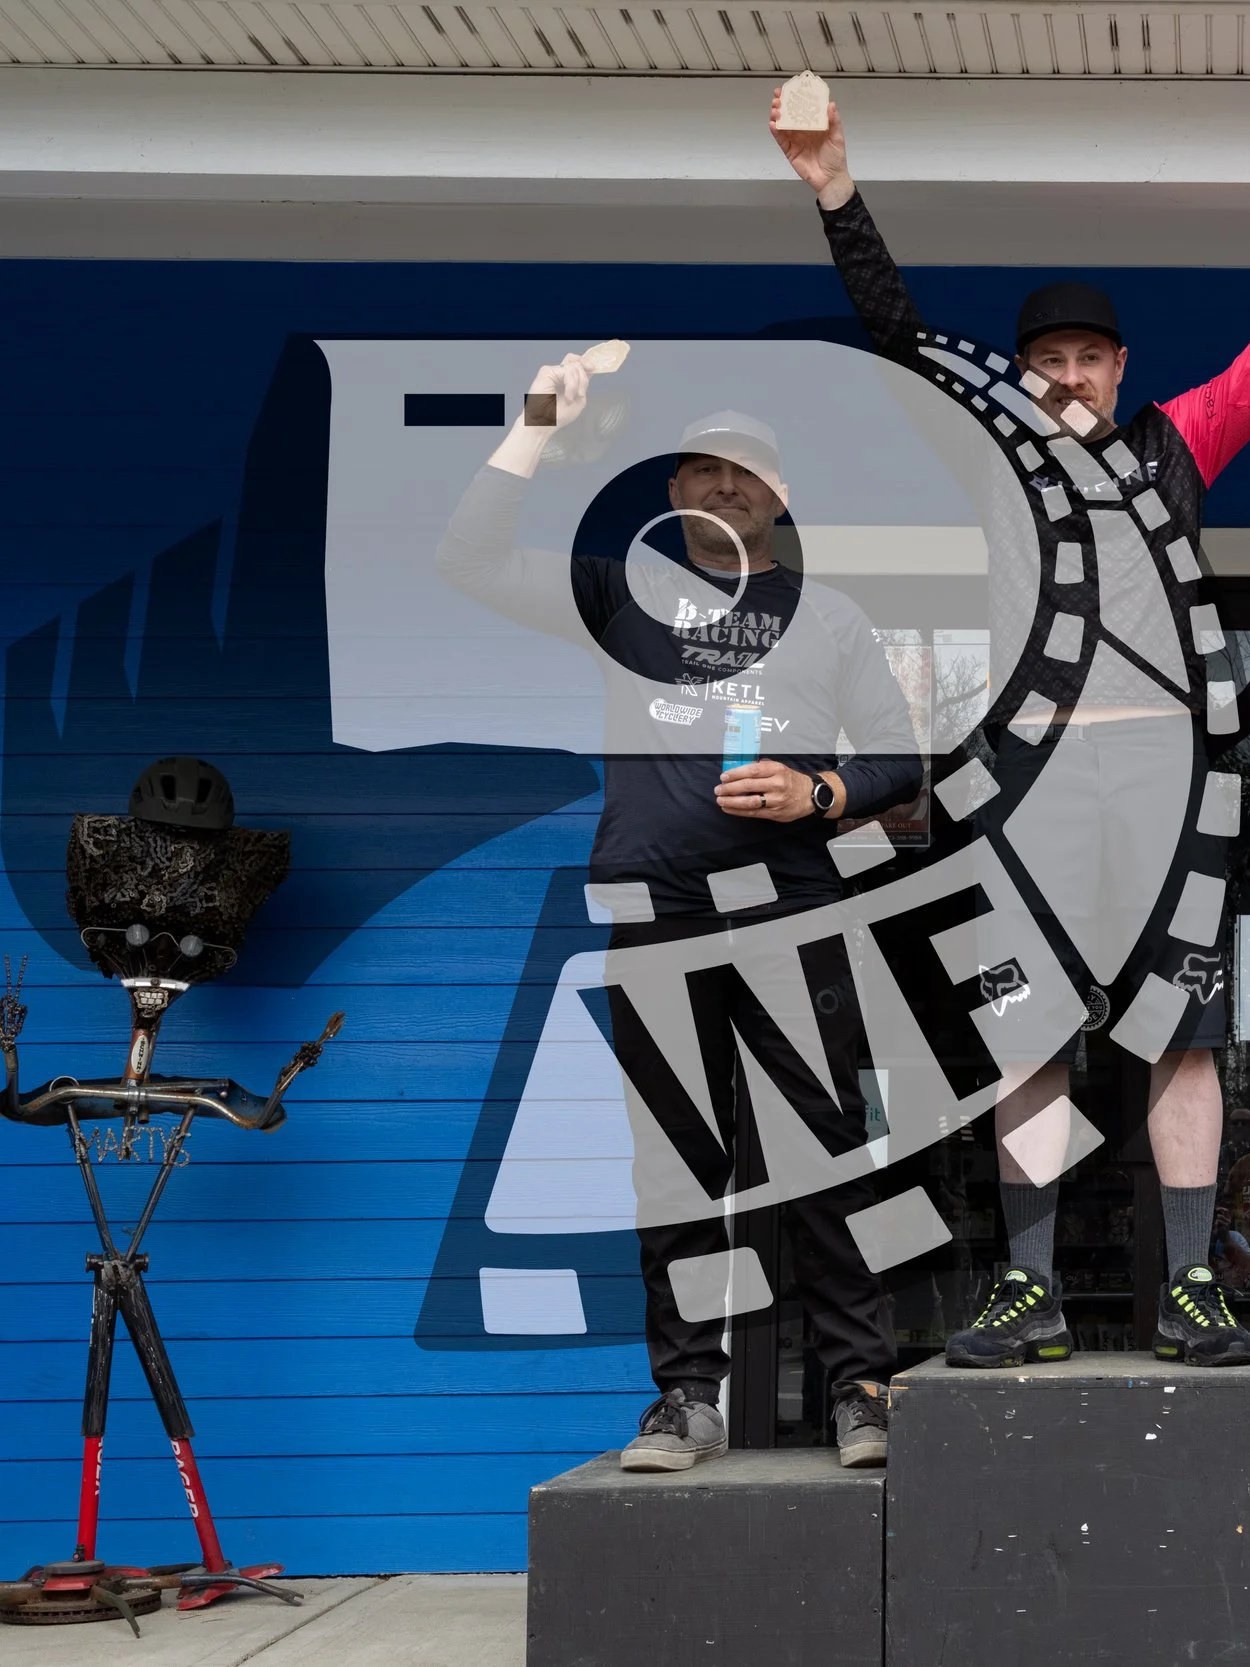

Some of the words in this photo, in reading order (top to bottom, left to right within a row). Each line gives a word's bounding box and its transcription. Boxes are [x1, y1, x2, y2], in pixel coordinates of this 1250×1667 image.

[672, 620, 780, 649] RACING
[717, 665, 763, 676] COMPONENTS
[712, 680, 765, 700] KETL
[711, 694, 739, 703] MOUNTAIN
[654, 702, 702, 717] WORLDWIDE
[760, 716, 790, 733] EV
